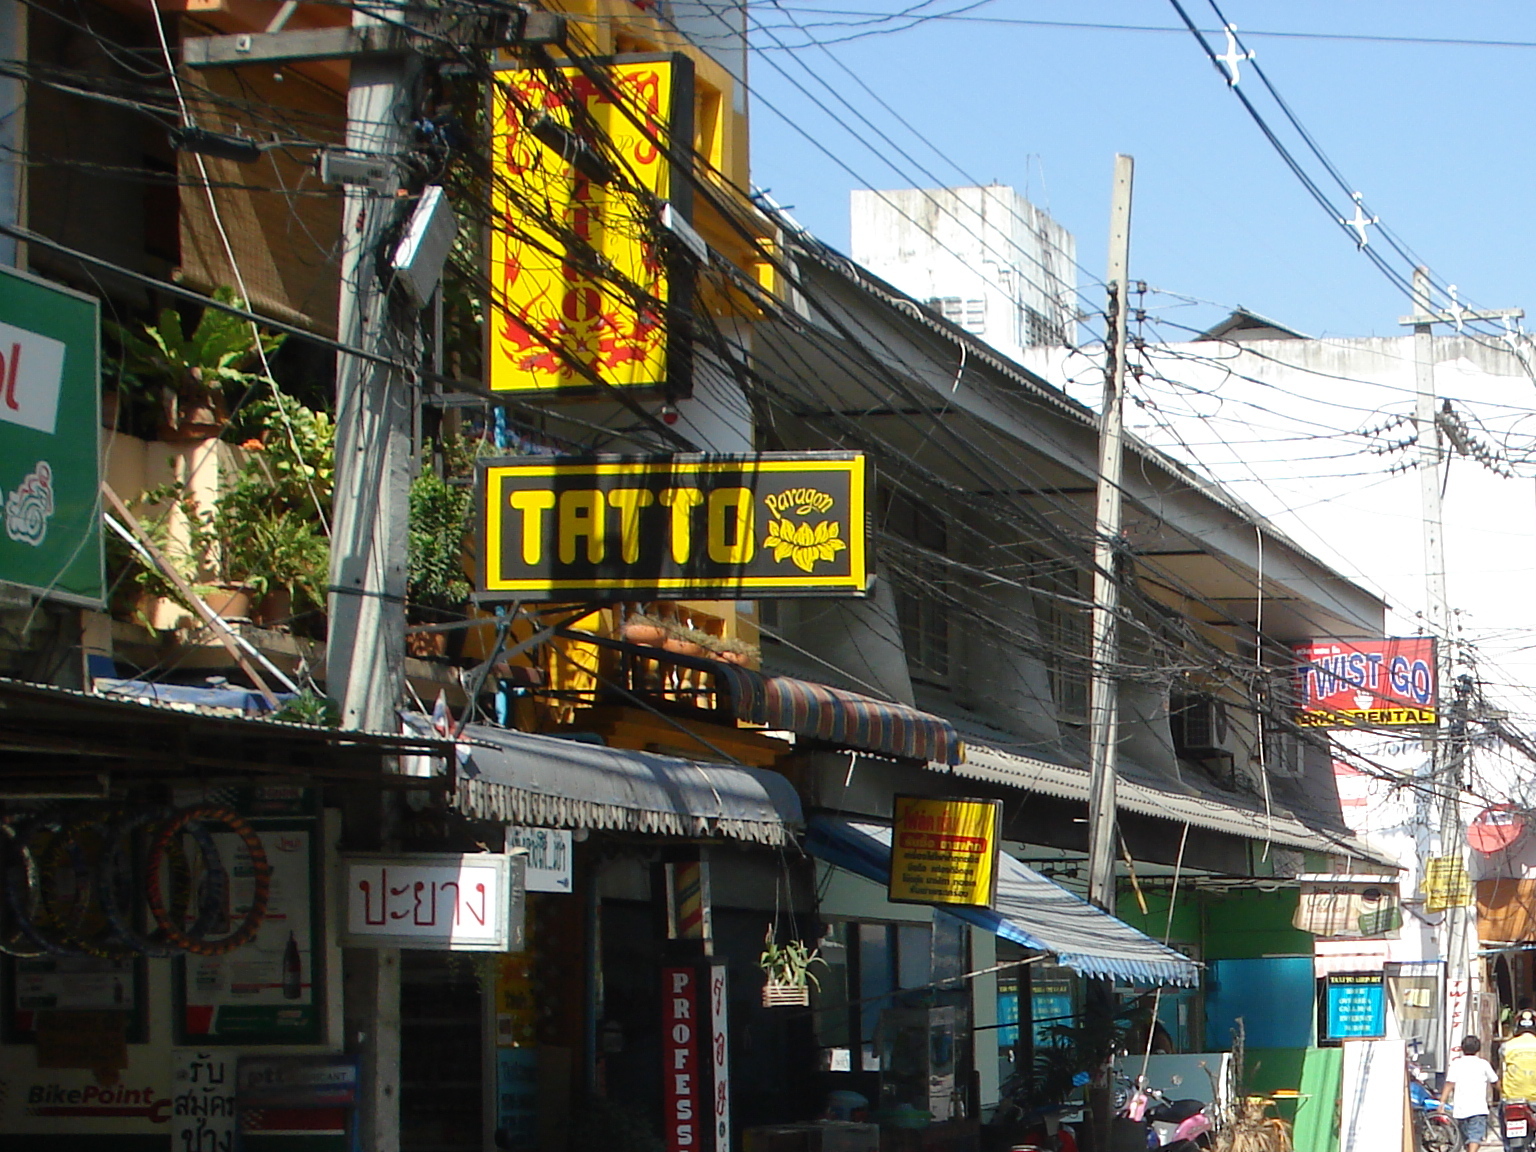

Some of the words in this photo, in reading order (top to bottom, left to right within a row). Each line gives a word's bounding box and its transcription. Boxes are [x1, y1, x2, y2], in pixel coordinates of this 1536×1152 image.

[764, 487, 834, 519] Paragon
[510, 487, 755, 565] TATTO
[1297, 652, 1383, 706] TWIST
[1390, 656, 1433, 704] GO
[1354, 711, 1429, 723] RENTAL
[359, 867, 485, 927] ปะยาง
[190, 1053, 224, 1084] รับ
[28, 1085, 155, 1104] BikePoint
